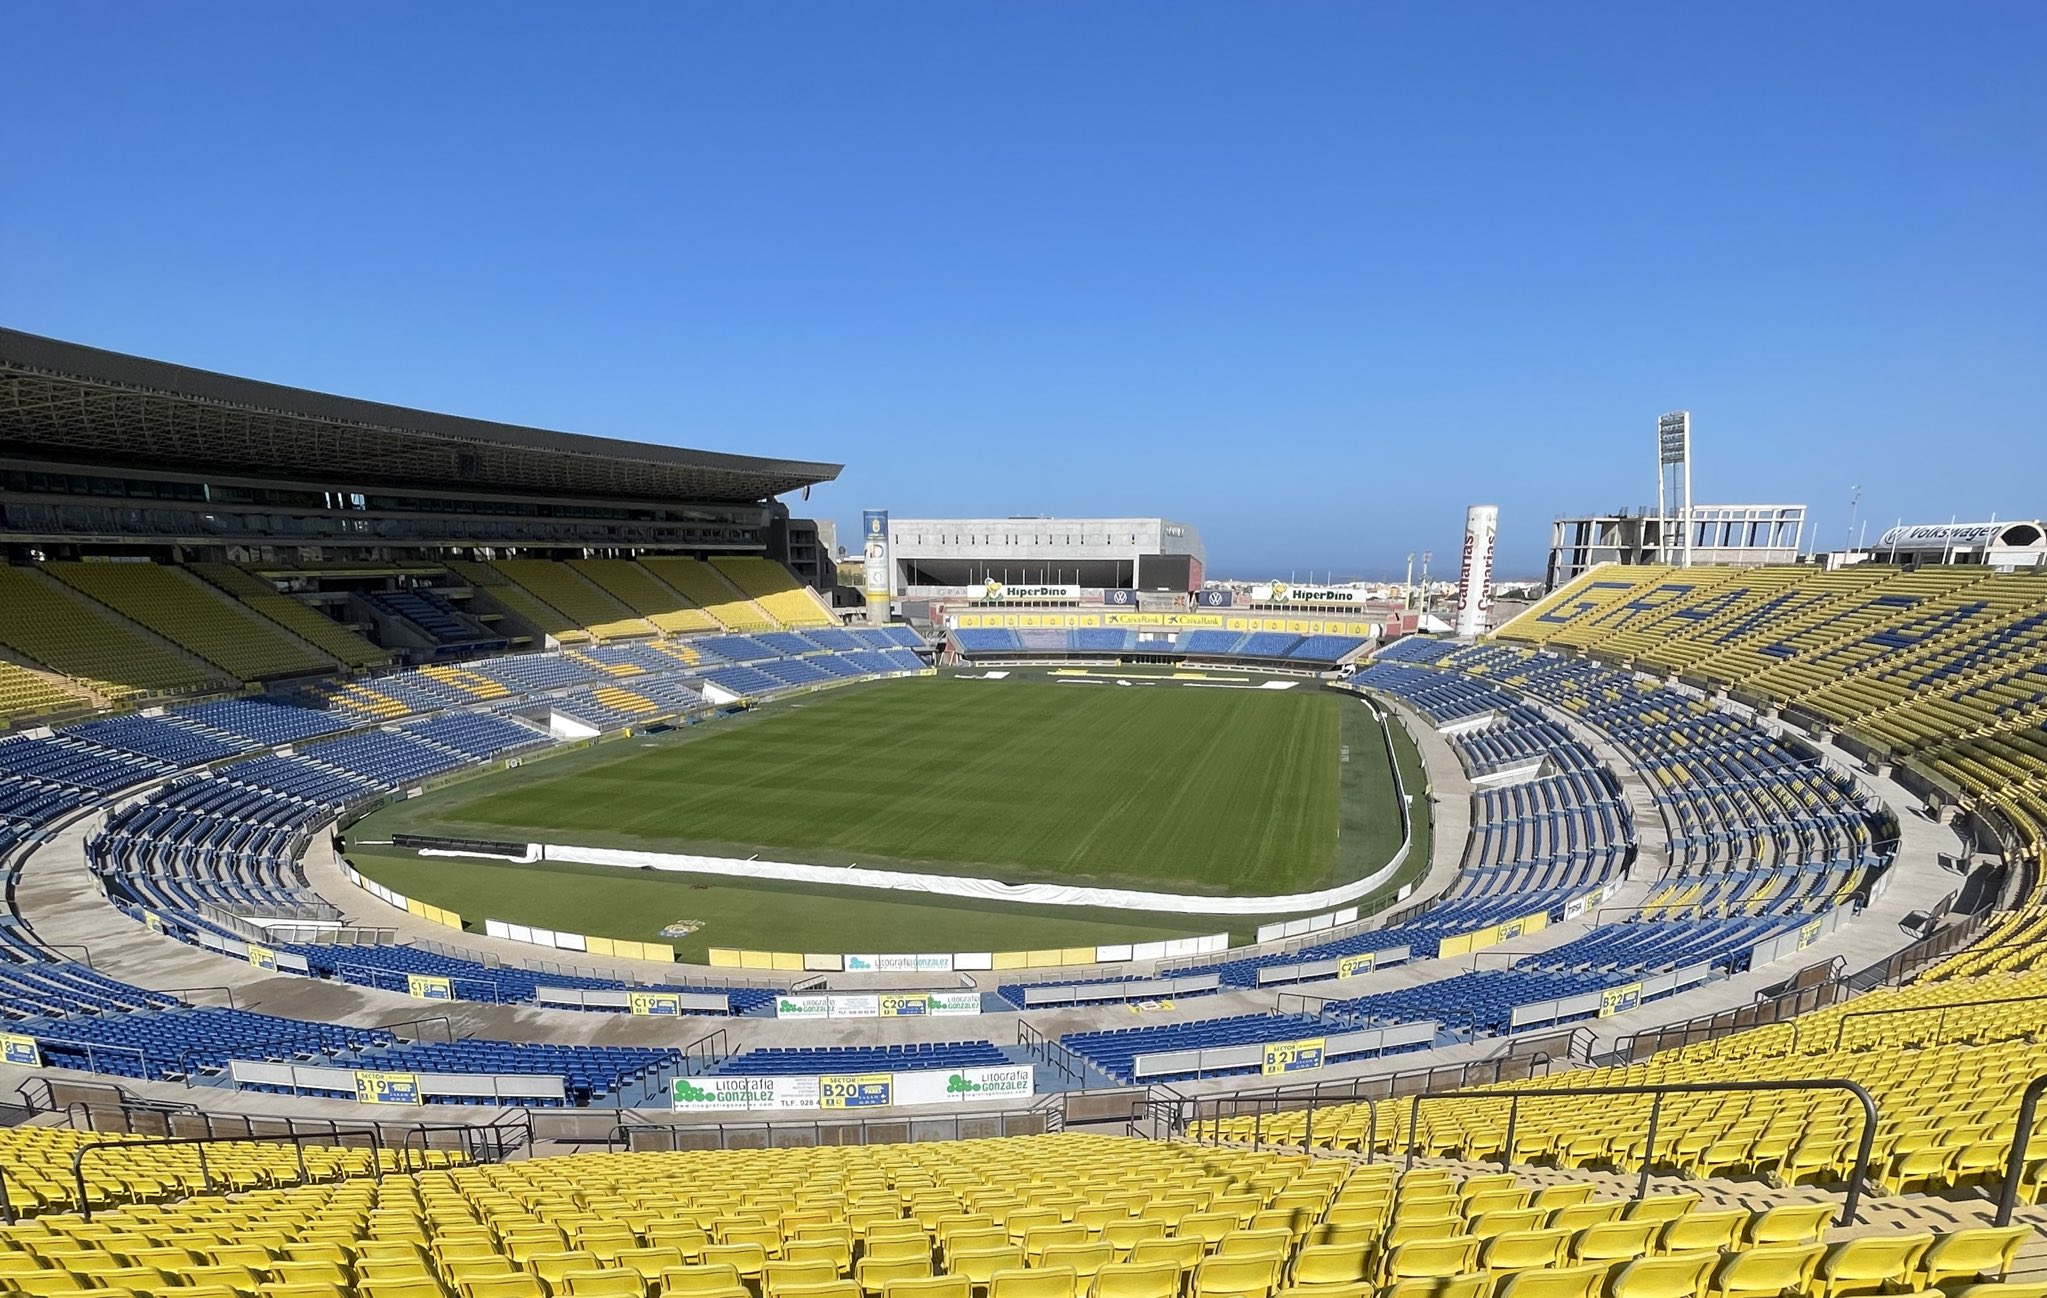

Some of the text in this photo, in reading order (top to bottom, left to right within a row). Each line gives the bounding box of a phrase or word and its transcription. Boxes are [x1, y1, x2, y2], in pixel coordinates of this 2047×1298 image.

[1007, 587, 1067, 598] HiperDino
[1292, 590, 1353, 601] HiperDino
[634, 998, 656, 1008] C19
[882, 1000, 905, 1009] C20
[1603, 994, 1623, 1007] B22
[1267, 1051, 1296, 1064] B21
[357, 1079, 386, 1092] B19
[823, 1084, 857, 1097] B20
